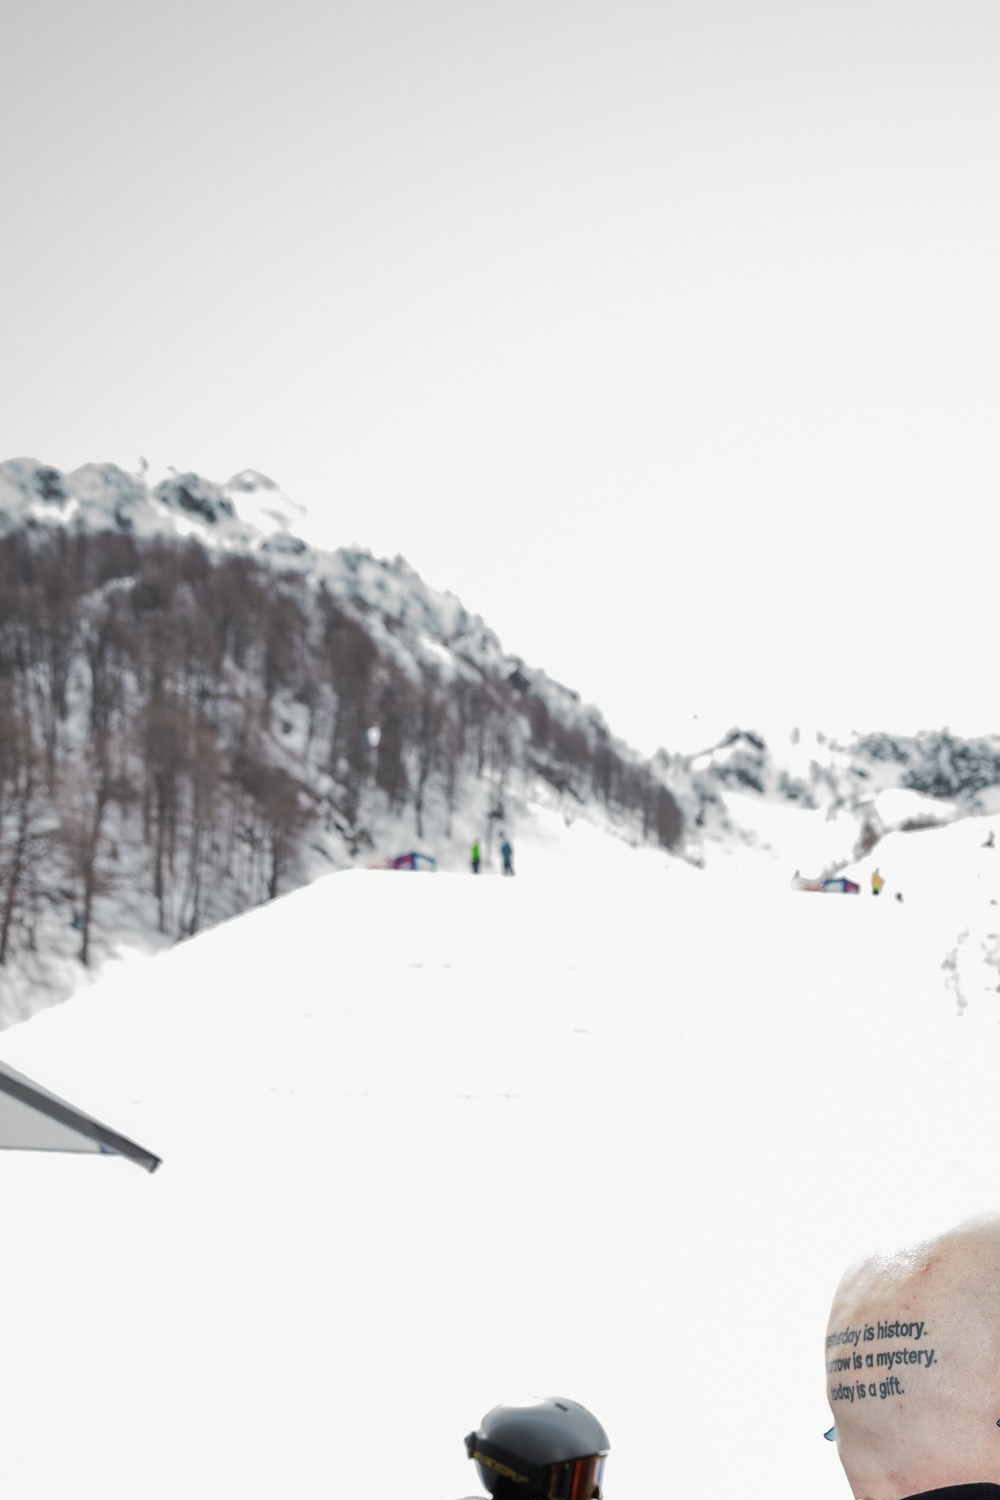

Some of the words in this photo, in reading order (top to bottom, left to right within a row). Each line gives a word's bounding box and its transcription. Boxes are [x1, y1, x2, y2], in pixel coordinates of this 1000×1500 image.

[863, 1324, 875, 1342] is
[877, 1320, 928, 1341] history.
[852, 1352, 863, 1370] is
[866, 1353, 874, 1368] a
[877, 1347, 938, 1371] mystery.
[856, 1380, 866, 1400] is
[869, 1382, 877, 1397] a
[879, 1375, 905, 1399] gift.
